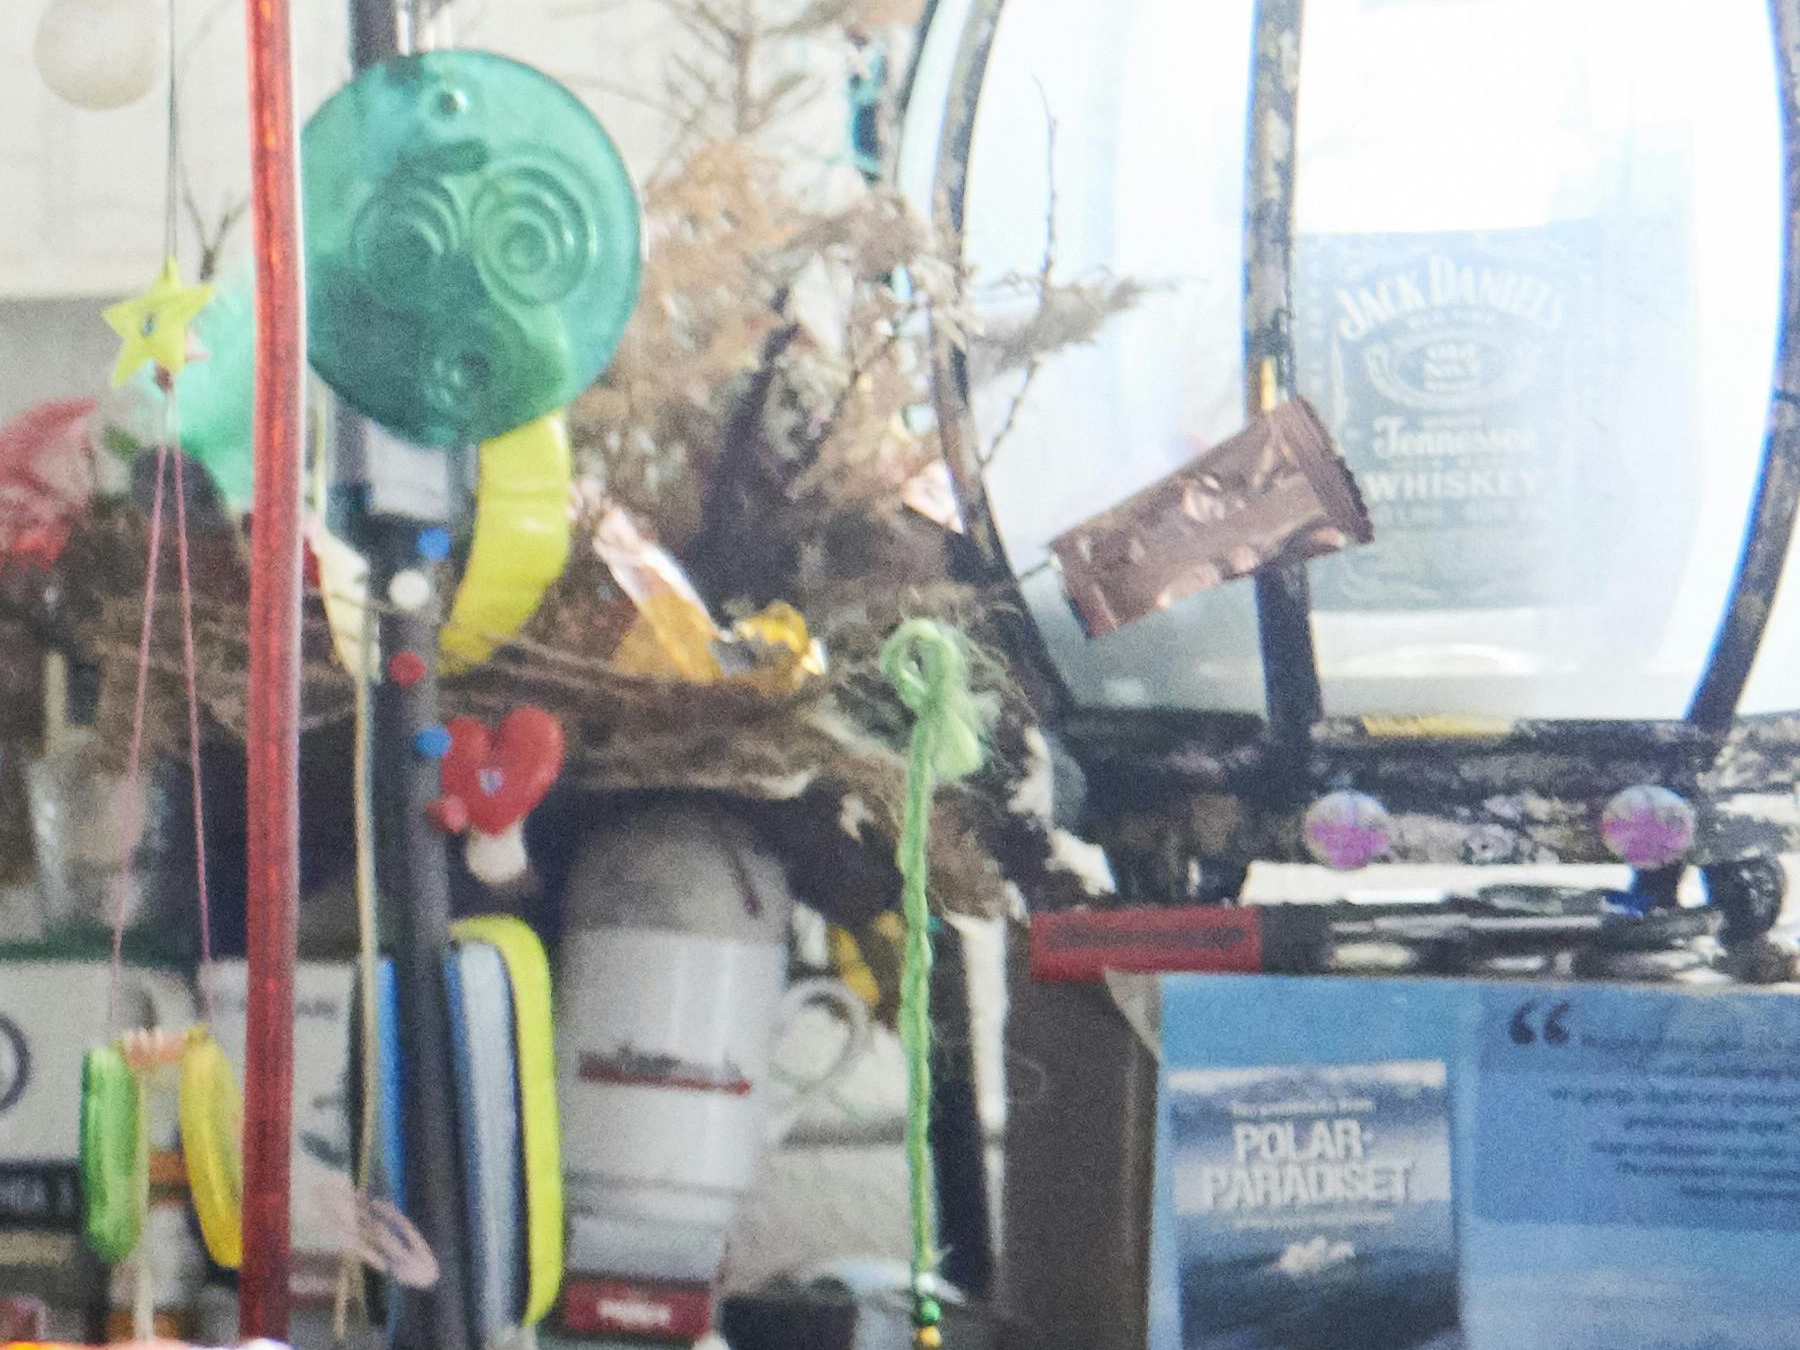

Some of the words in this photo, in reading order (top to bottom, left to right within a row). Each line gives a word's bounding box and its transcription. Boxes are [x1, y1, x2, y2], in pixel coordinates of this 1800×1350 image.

[1336, 270, 1426, 340] JACK
[1364, 471, 1539, 502] WHISKEY
[1205, 1159, 1415, 1211] PARADISET
